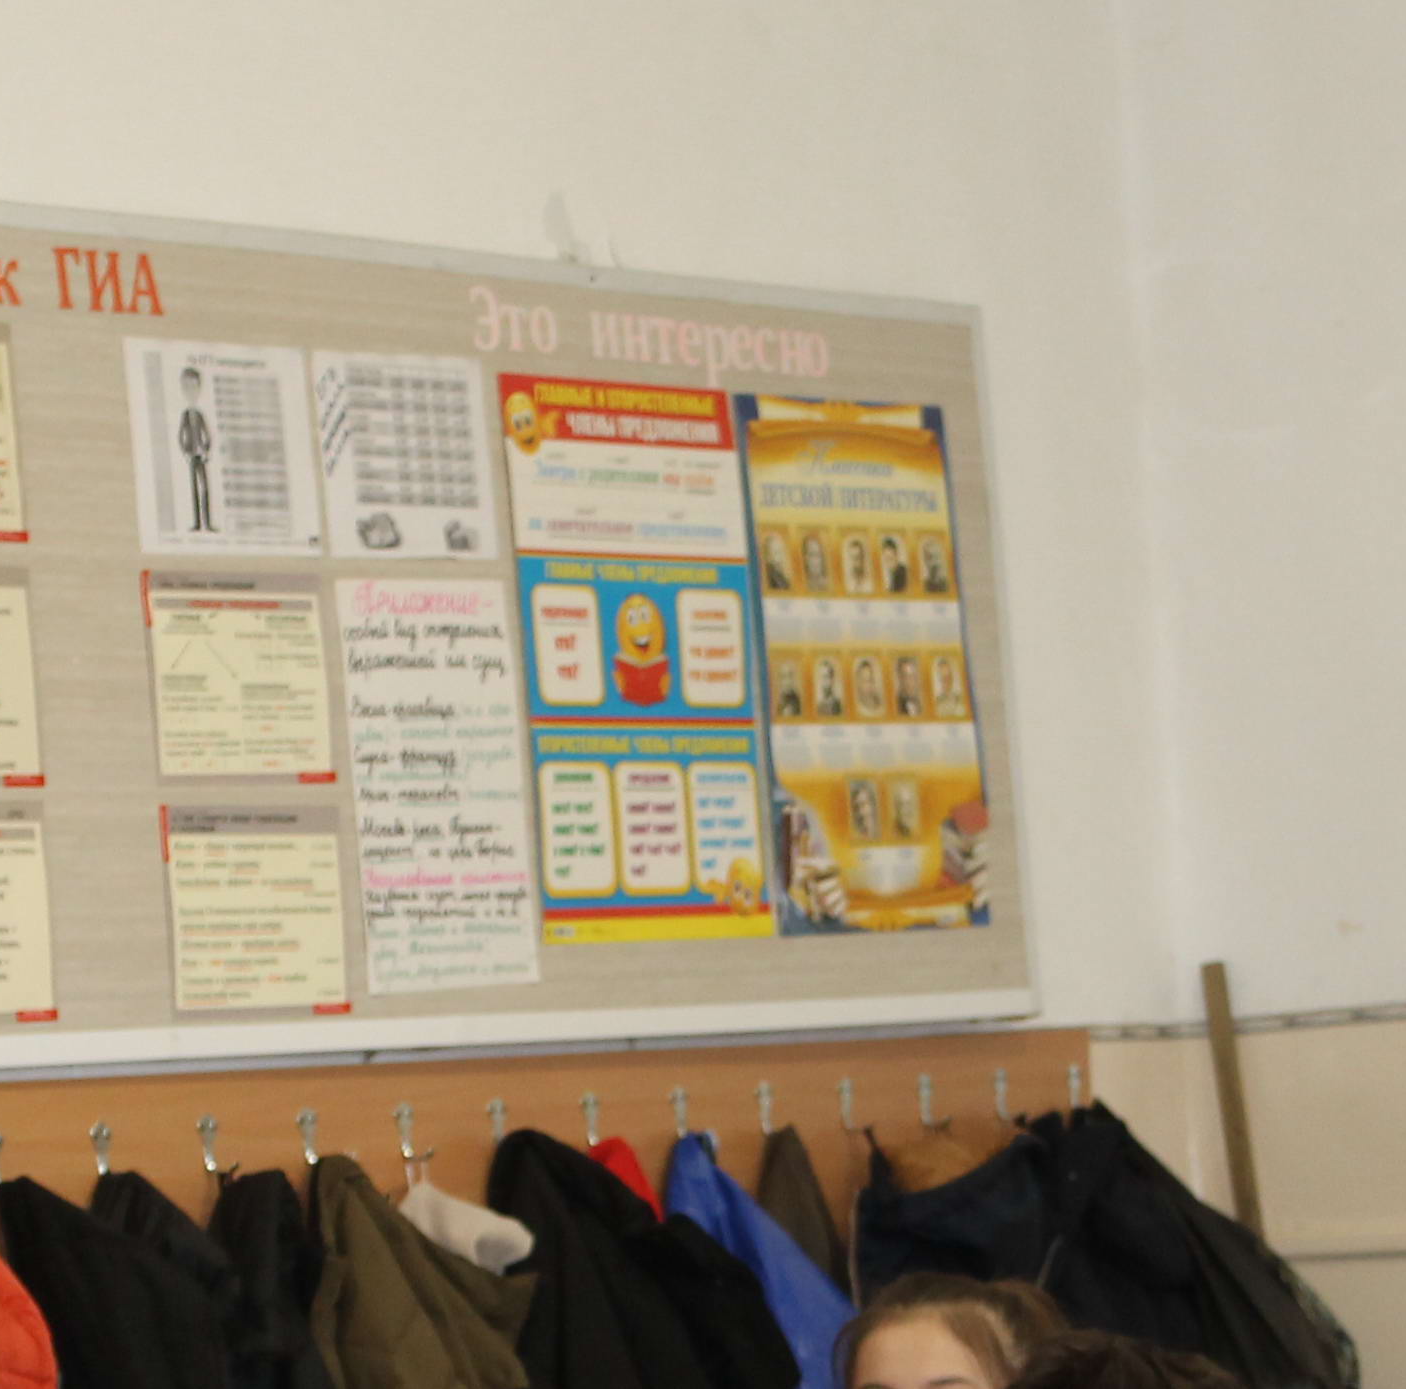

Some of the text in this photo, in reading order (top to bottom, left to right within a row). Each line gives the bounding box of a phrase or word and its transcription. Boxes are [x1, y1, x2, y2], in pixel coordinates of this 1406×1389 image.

[52, 247, 166, 317] ГИА
[469, 285, 831, 382] Это интересно
[566, 412, 722, 444] ЧЛЕНЫ ПРЕДЛОЖЕНИЯ
